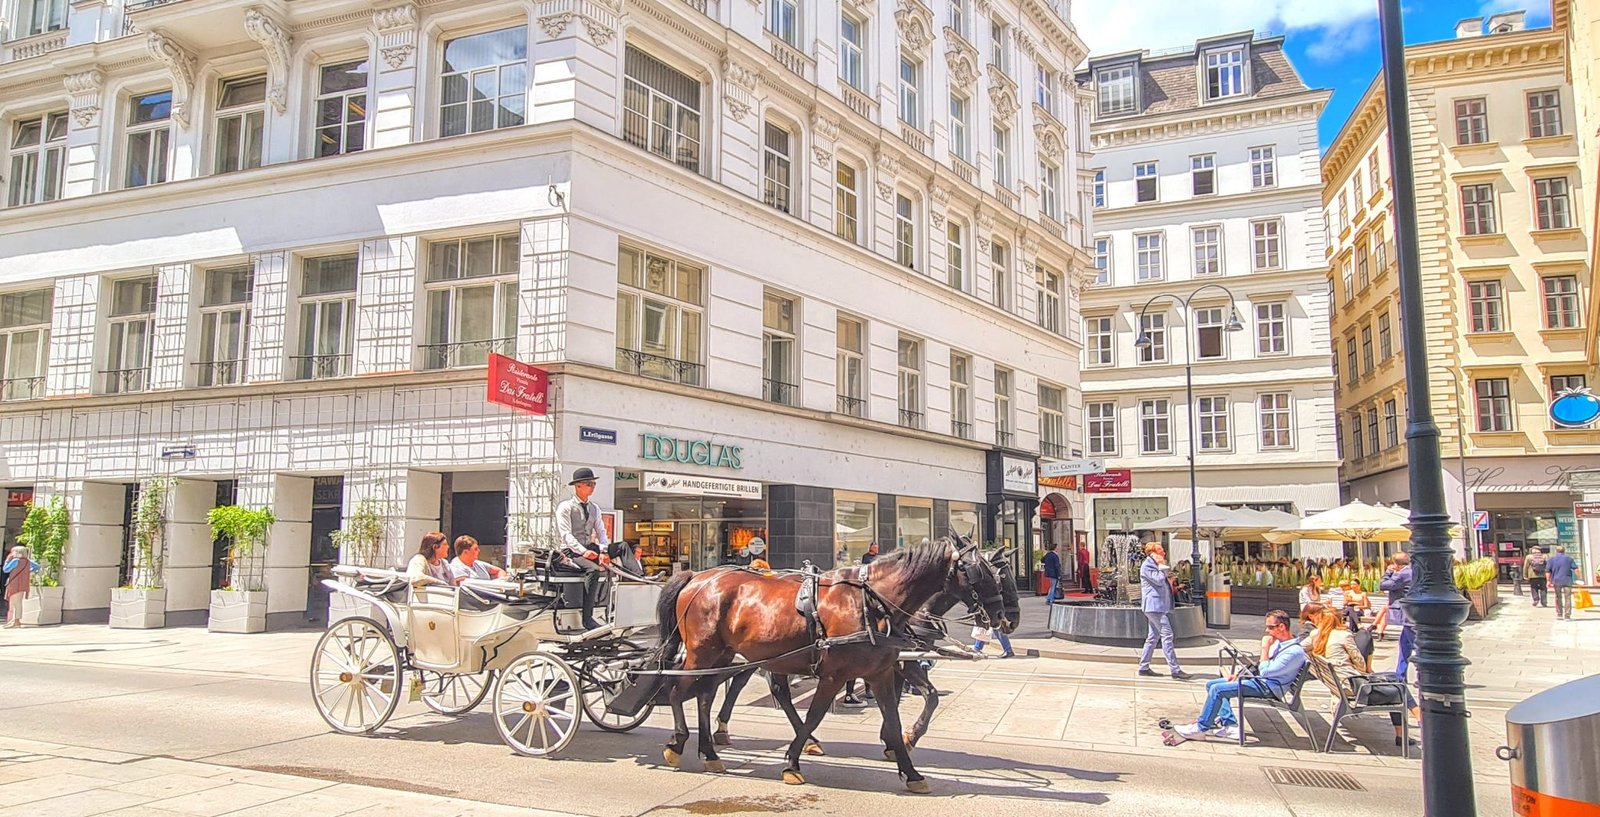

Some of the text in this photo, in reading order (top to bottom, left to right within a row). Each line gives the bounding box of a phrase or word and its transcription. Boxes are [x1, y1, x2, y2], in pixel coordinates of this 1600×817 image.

[507, 362, 538, 381] Ristorante
[500, 380, 516, 396] Dai
[515, 385, 544, 404] Fratelli
[642, 433, 742, 469] DOUGLAS
[682, 479, 735, 492] HANDGEFERTIGTE
[736, 485, 759, 494] BRILLEN
[1102, 480, 1130, 488] Fratelli
[1102, 508, 1160, 516] FERMAN
